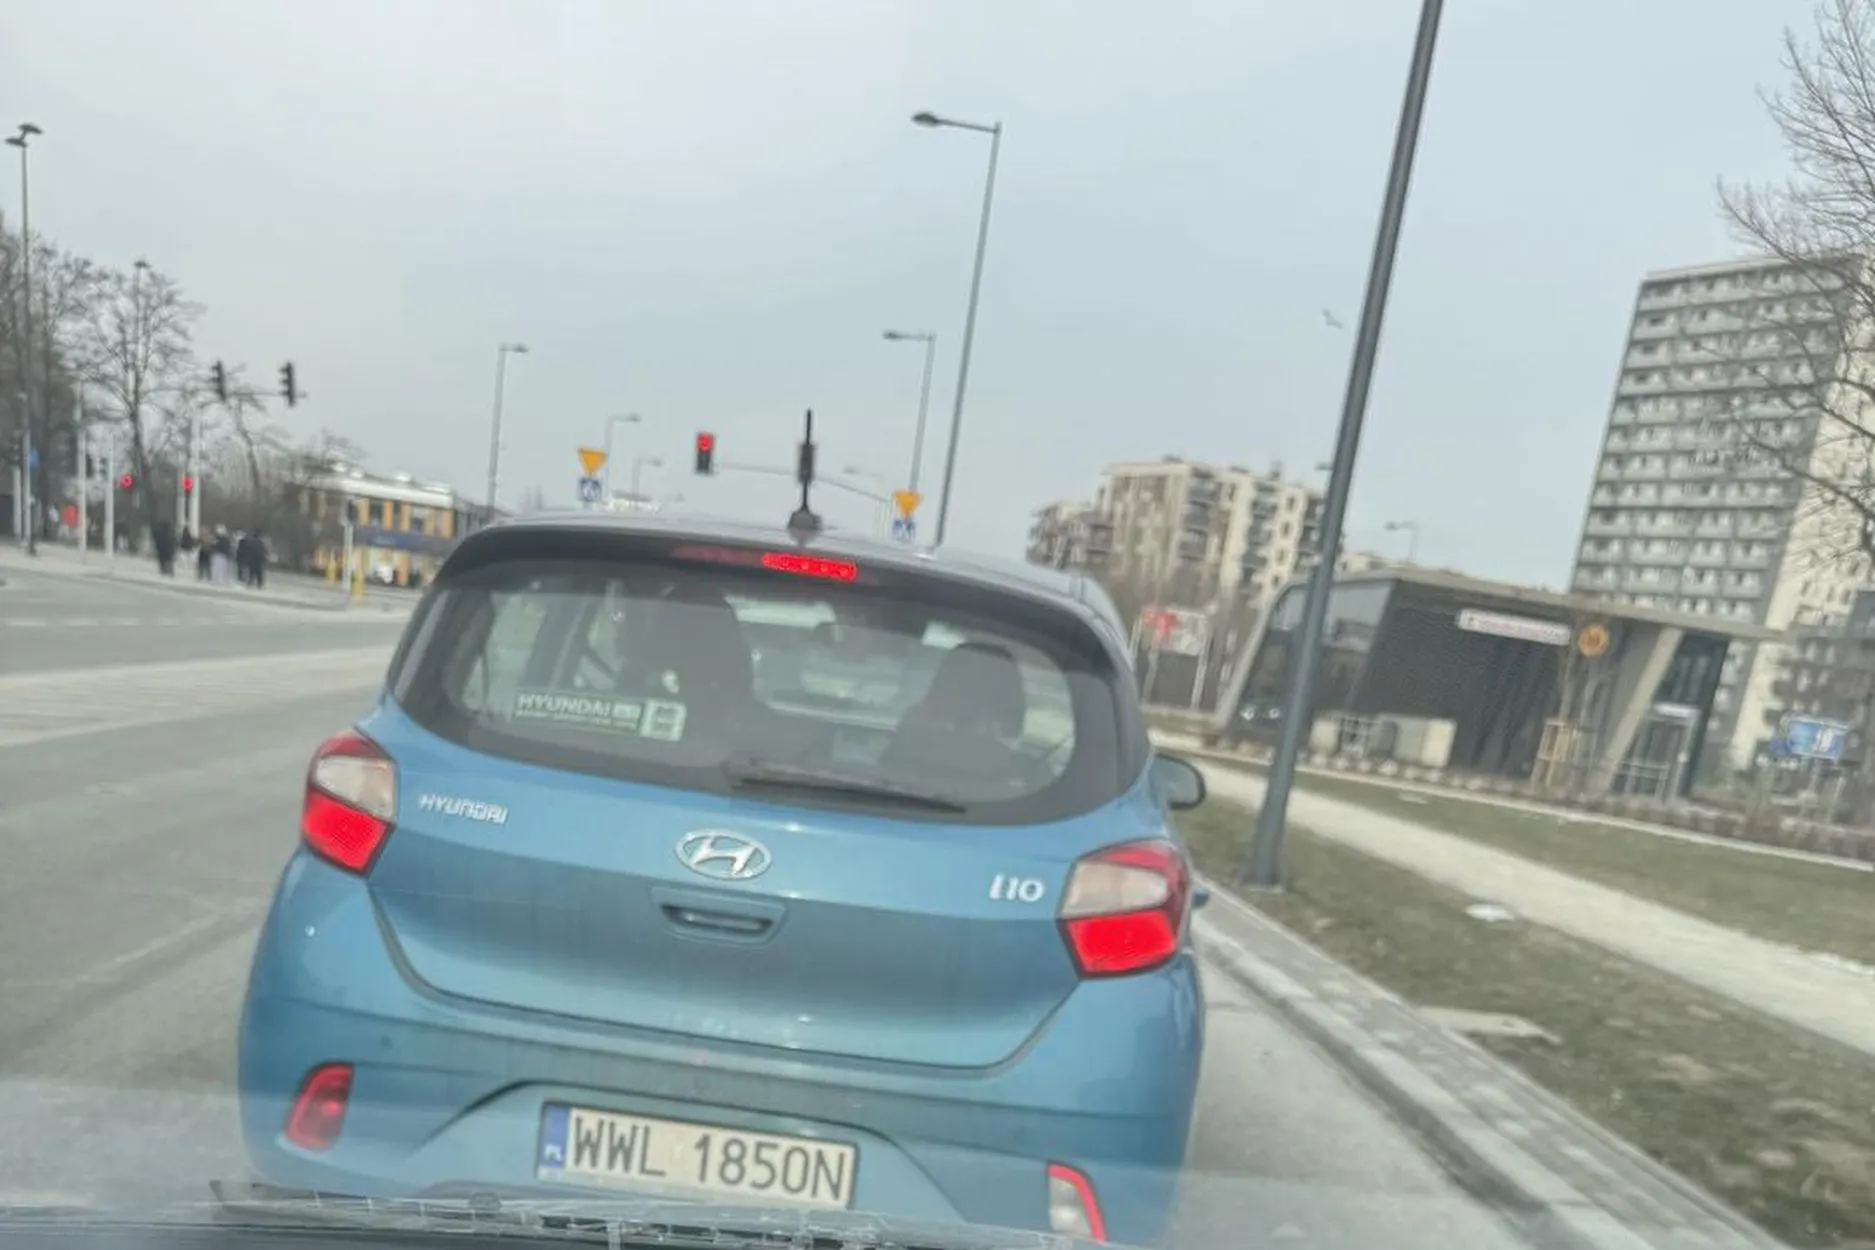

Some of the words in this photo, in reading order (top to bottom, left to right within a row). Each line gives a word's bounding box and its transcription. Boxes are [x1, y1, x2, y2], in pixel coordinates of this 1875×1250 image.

[517, 694, 612, 718] HYUNDAI
[418, 793, 509, 825] HYUNDAI
[573, 1116, 666, 1177] WWL
[694, 1133, 846, 1201] 1850N
